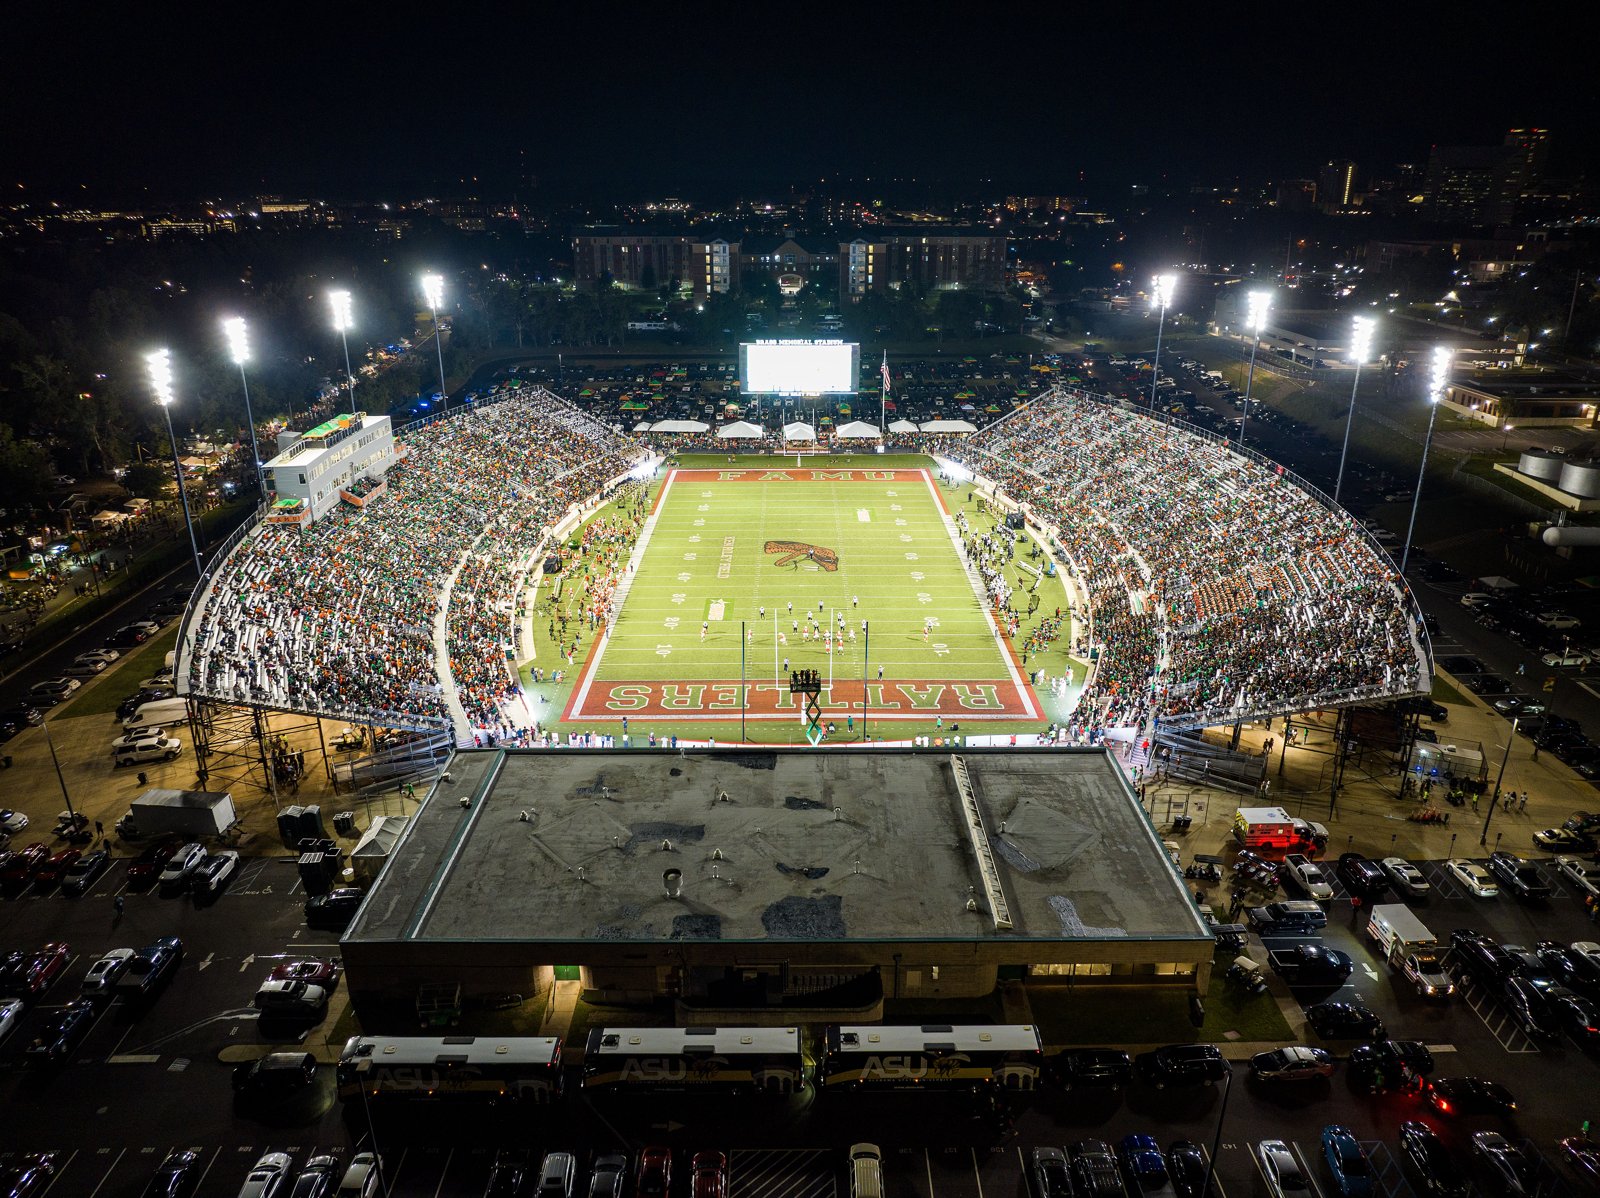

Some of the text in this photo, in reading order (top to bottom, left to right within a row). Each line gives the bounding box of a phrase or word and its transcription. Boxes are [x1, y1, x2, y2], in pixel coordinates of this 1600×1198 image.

[717, 471, 896, 481] FAMU
[655, 644, 673, 655] 10
[932, 643, 950, 654] 10
[605, 684, 1006, 711] RATTLERS
[373, 1067, 440, 1090] ASU
[618, 1057, 687, 1081] ASU
[859, 1055, 928, 1079] ASU
